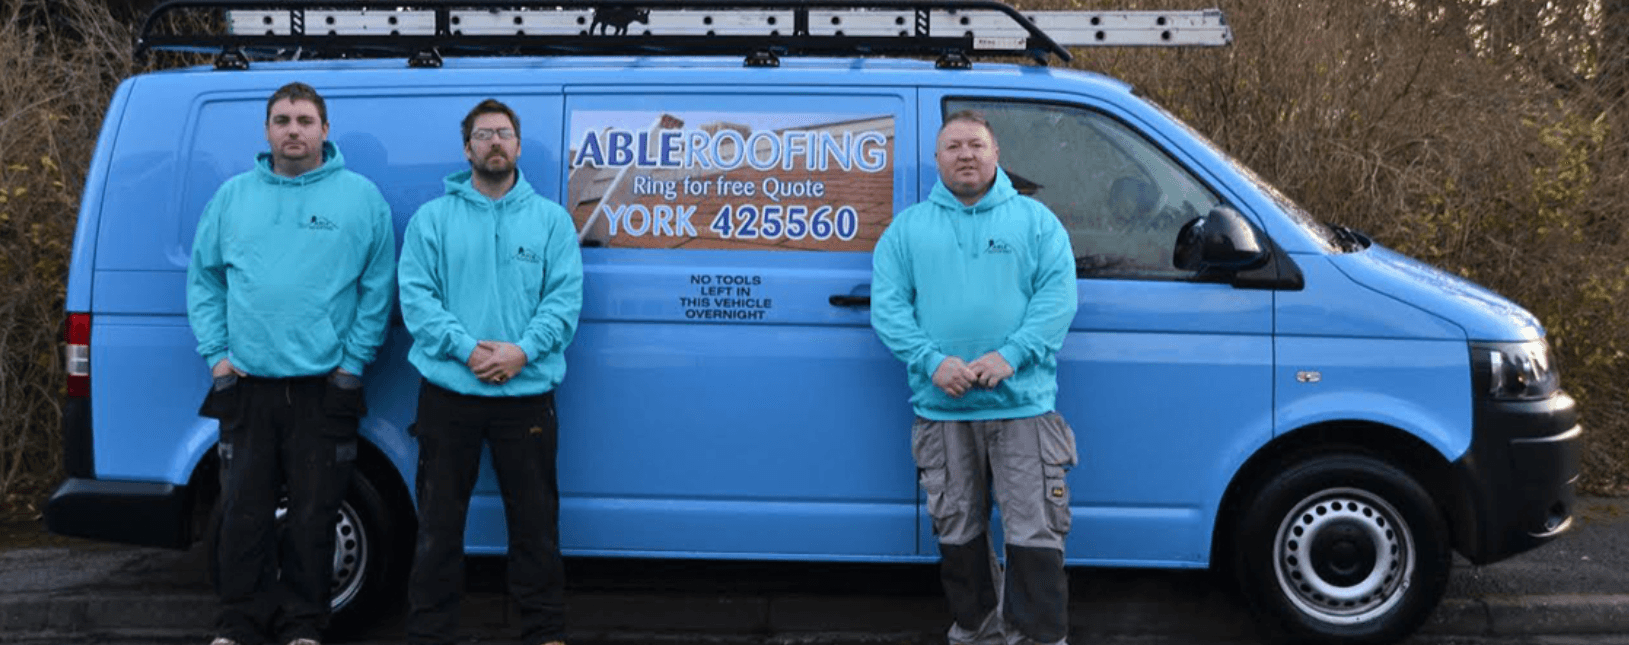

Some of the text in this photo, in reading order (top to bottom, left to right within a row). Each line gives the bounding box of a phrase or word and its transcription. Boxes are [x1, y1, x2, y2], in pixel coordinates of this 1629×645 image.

[633, 175, 824, 201] Ring for free Quote
[602, 204, 858, 240] YORK 425560
[691, 275, 761, 285] NO TOOLS
[700, 287, 750, 297] LEFT IN
[680, 297, 772, 309] THIS VEHICLE
[685, 309, 766, 320] OVERNIGHT
